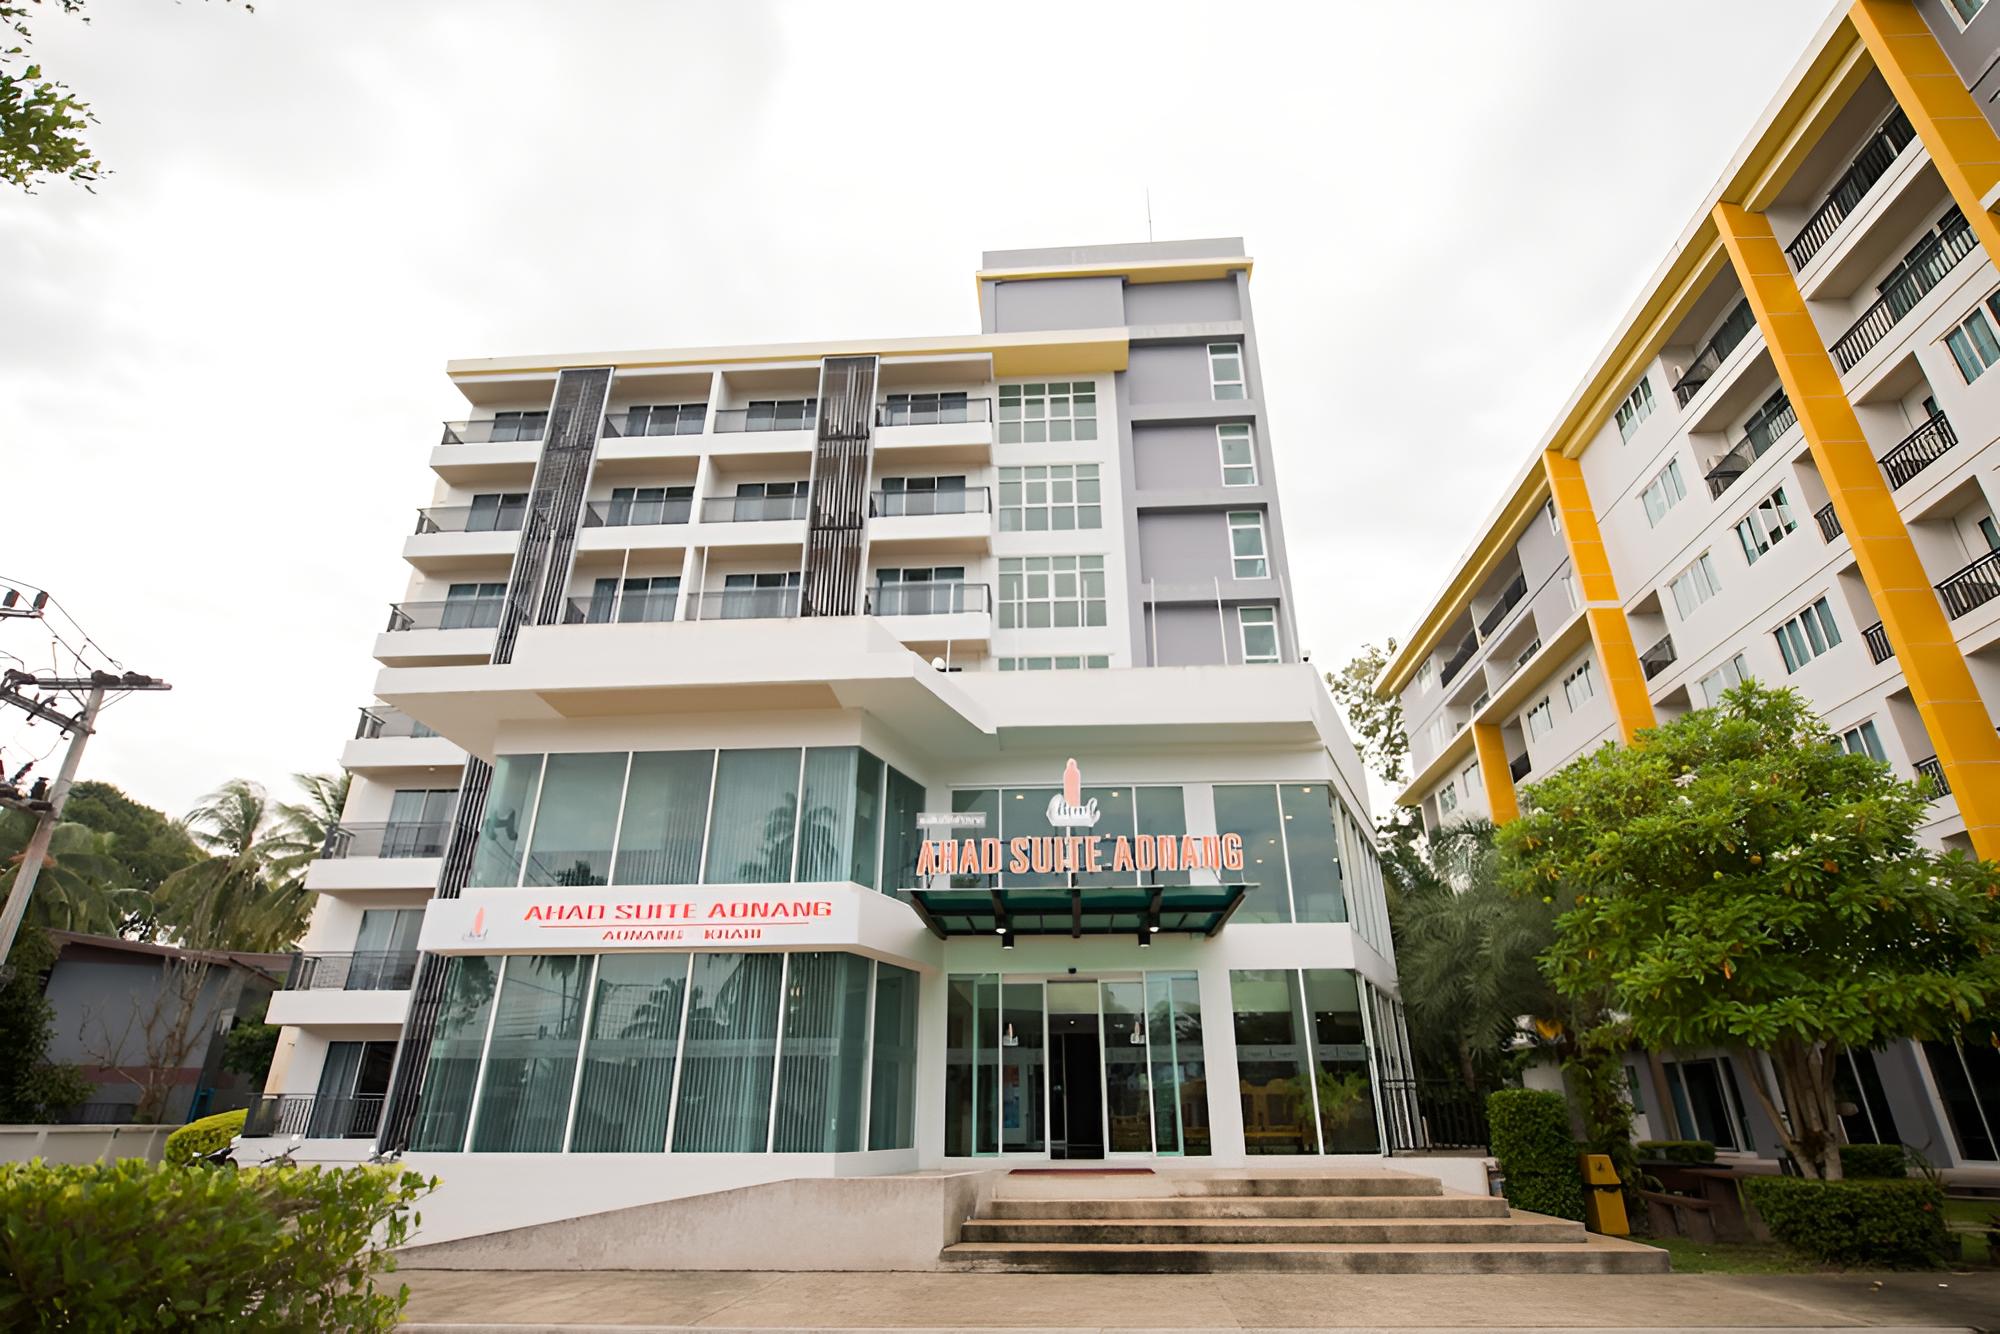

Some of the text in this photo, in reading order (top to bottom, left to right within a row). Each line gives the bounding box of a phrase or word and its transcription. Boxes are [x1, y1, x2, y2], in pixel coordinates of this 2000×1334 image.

[916, 832, 1243, 876] AHAD SUITE AONANG
[524, 902, 832, 920] AHAD SUITE AONANG
